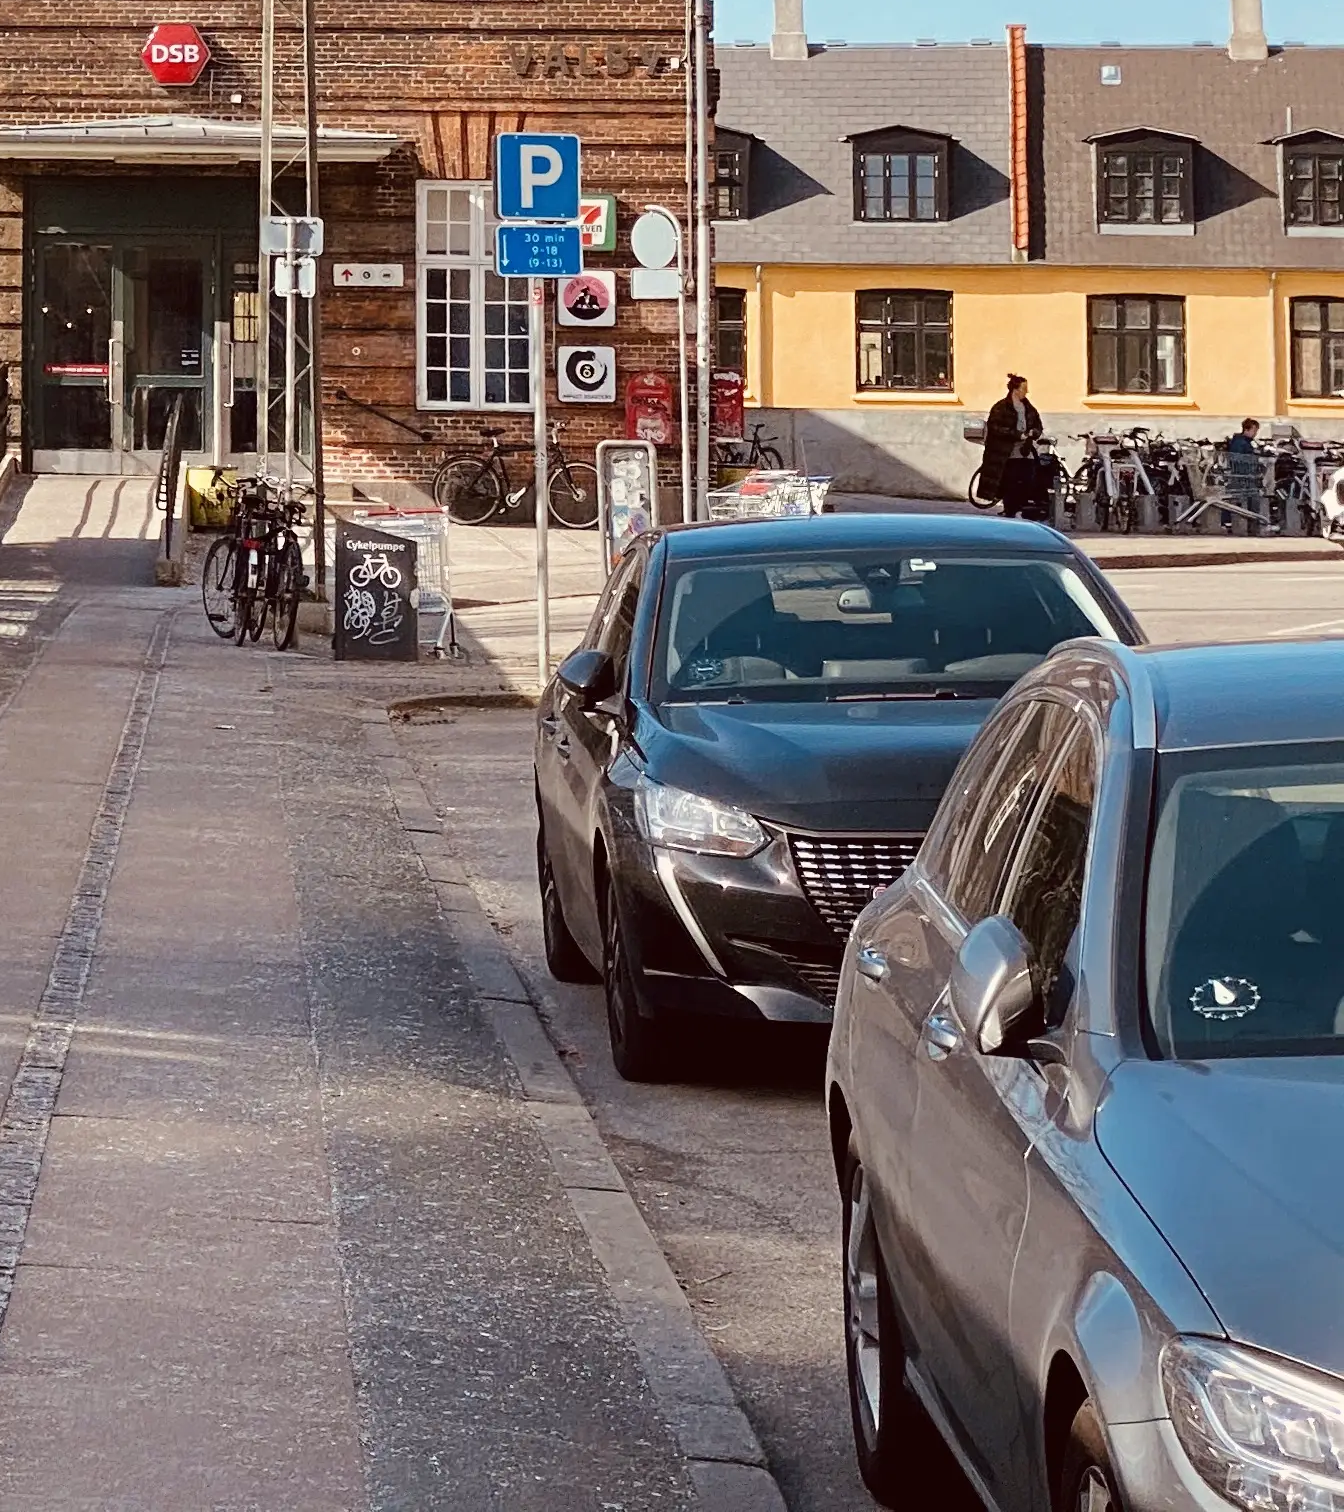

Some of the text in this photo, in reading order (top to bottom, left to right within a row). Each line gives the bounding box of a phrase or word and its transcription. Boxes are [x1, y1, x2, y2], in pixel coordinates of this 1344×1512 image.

[152, 44, 200, 63] DSB
[508, 43, 662, 76] VALBY
[520, 144, 563, 208] P
[525, 233, 565, 243] 30 min
[529, 258, 563, 268] (9-13)
[346, 540, 406, 552] Cykelpumpe
